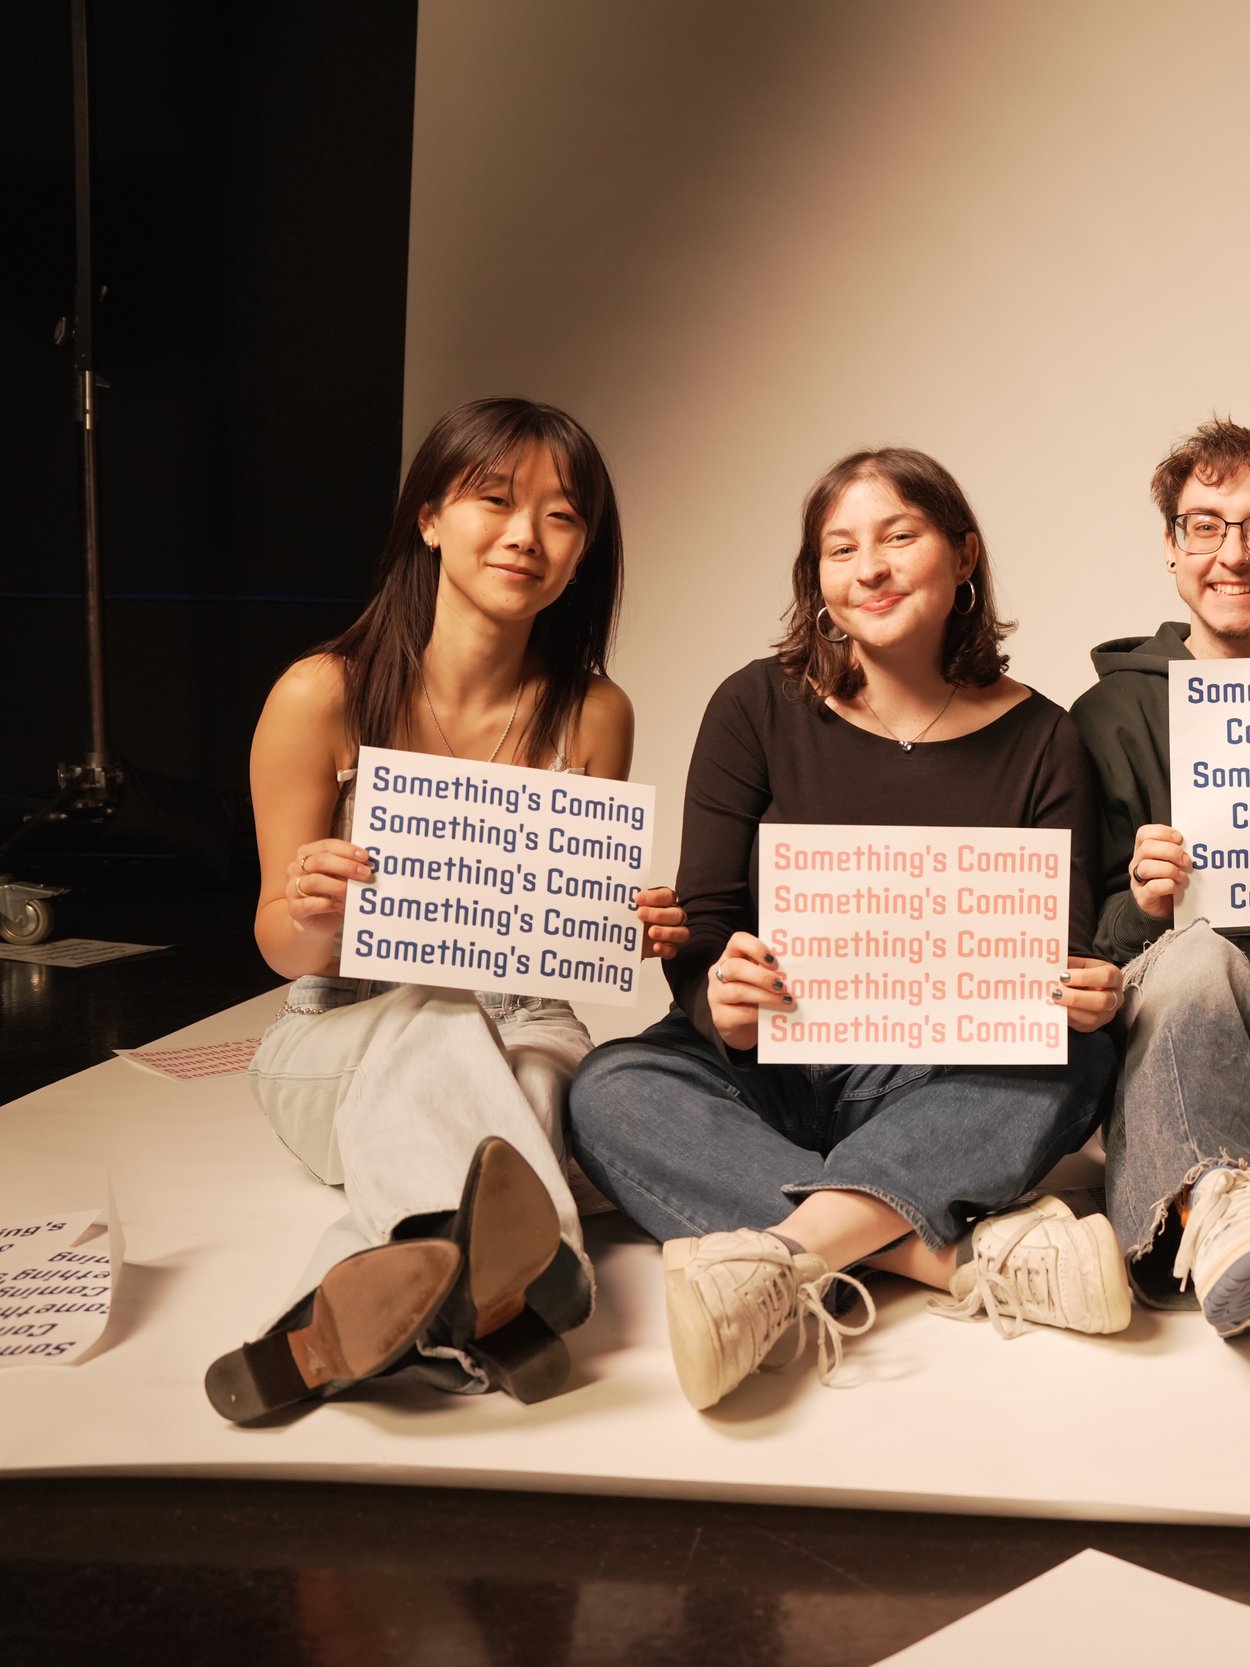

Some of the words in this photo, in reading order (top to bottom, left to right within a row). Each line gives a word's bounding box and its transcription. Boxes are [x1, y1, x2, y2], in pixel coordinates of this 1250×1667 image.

[372, 766, 541, 813] Something's
[551, 789, 644, 830] Coming
[369, 806, 538, 852] Something's
[549, 828, 641, 869] Coming
[774, 843, 947, 878] Something's
[957, 844, 1058, 878] Coming
[367, 846, 536, 894] Something's
[546, 868, 641, 911] Coming
[774, 885, 946, 920] Something's
[957, 887, 1057, 920] Coming
[359, 888, 533, 936] Something's
[544, 909, 637, 952] Coming
[771, 929, 946, 963] Something's
[957, 930, 1060, 964] Coming
[355, 930, 529, 977] Something's
[540, 950, 633, 992] Coming
[770, 1014, 946, 1049] Something's
[956, 1015, 1059, 1048] Coming
